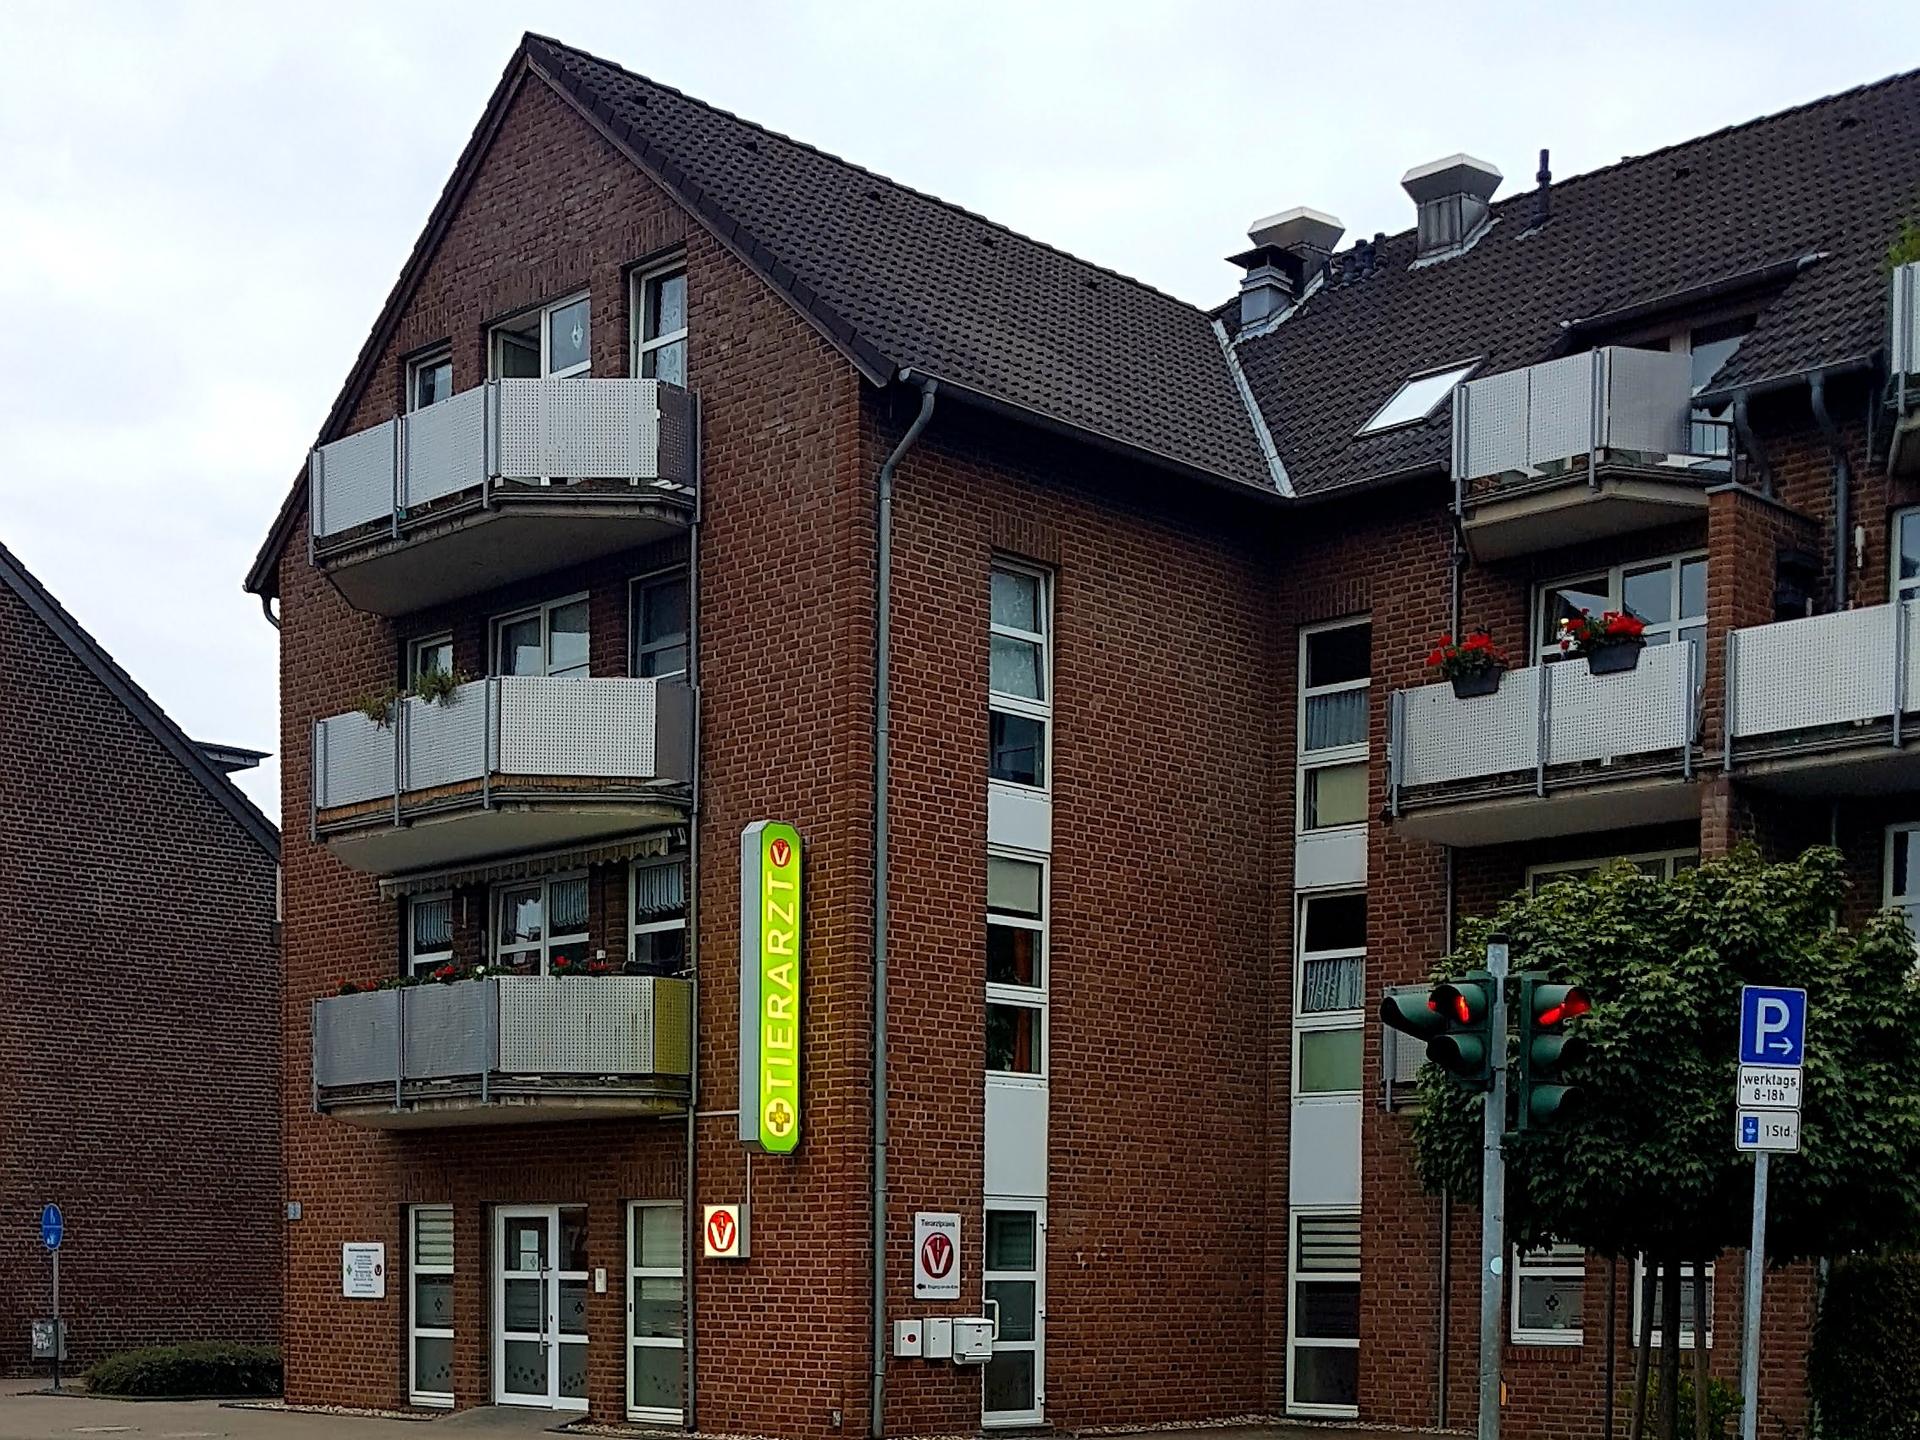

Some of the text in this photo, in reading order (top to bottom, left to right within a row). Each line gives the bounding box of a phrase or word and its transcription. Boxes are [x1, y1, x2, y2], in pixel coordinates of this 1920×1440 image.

[767, 871, 794, 1094] TIERARZT
[1755, 997, 1790, 1054] P
[1743, 1073, 1796, 1089] werktags
[1754, 1088, 1785, 1101] 8-18h
